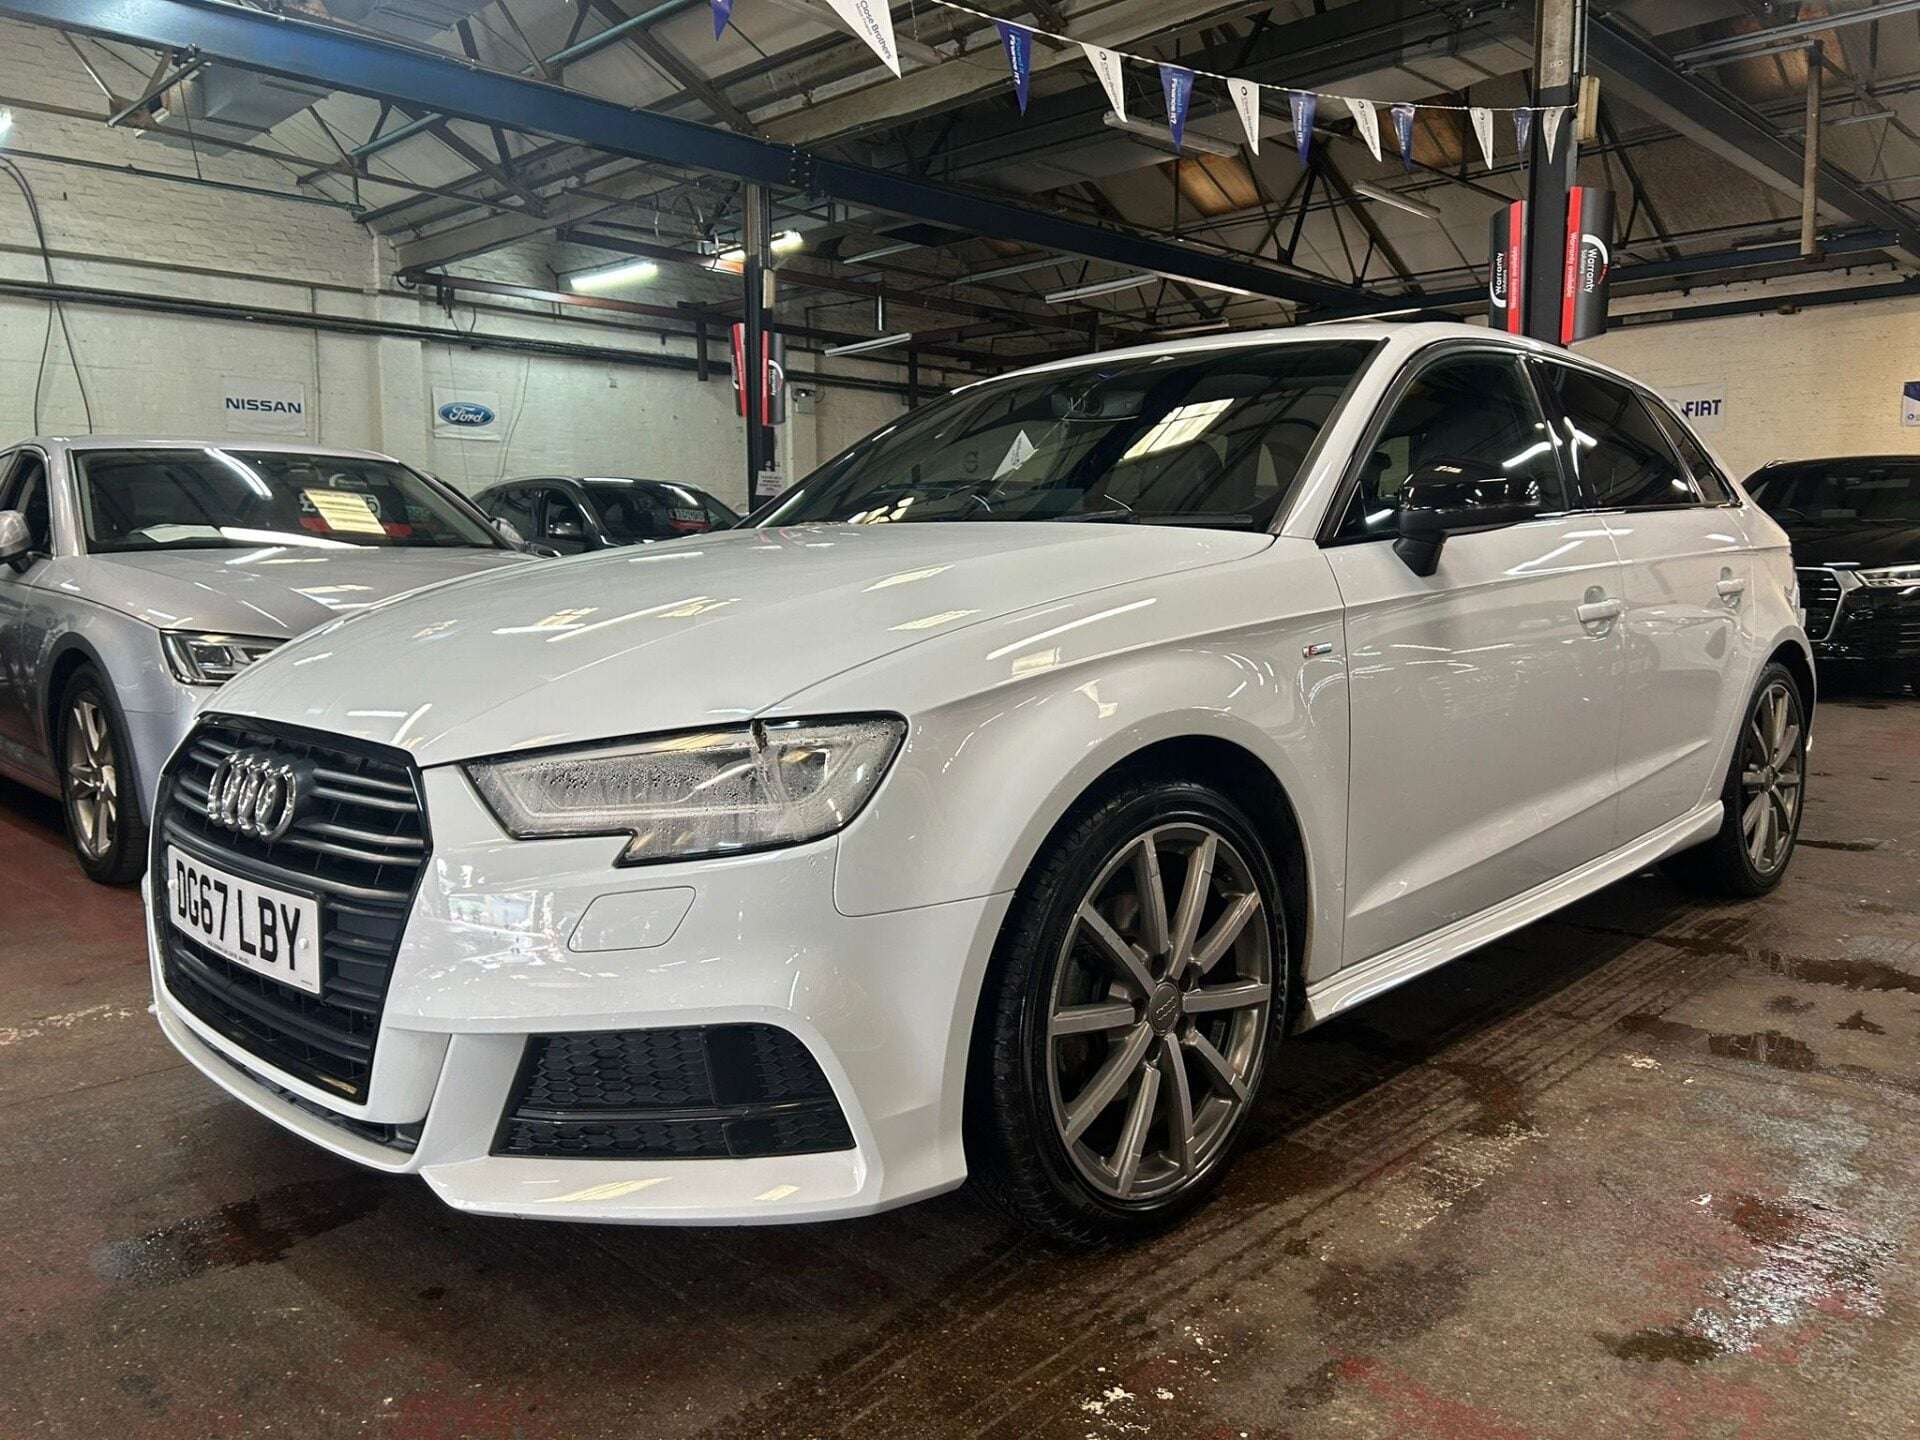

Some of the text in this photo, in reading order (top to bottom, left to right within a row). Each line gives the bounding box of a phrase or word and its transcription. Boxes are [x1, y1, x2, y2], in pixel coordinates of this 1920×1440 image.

[860, 0, 892, 60] Close Brothers
[1495, 252, 1505, 295] Warranty
[1566, 232, 1578, 298] Warranty available
[1584, 248, 1598, 293] Warranty
[225, 397, 302, 414] NISSAN
[449, 406, 484, 423] Ford
[1684, 399, 1722, 418] FIAT
[176, 859, 301, 971] DG67 LBY
